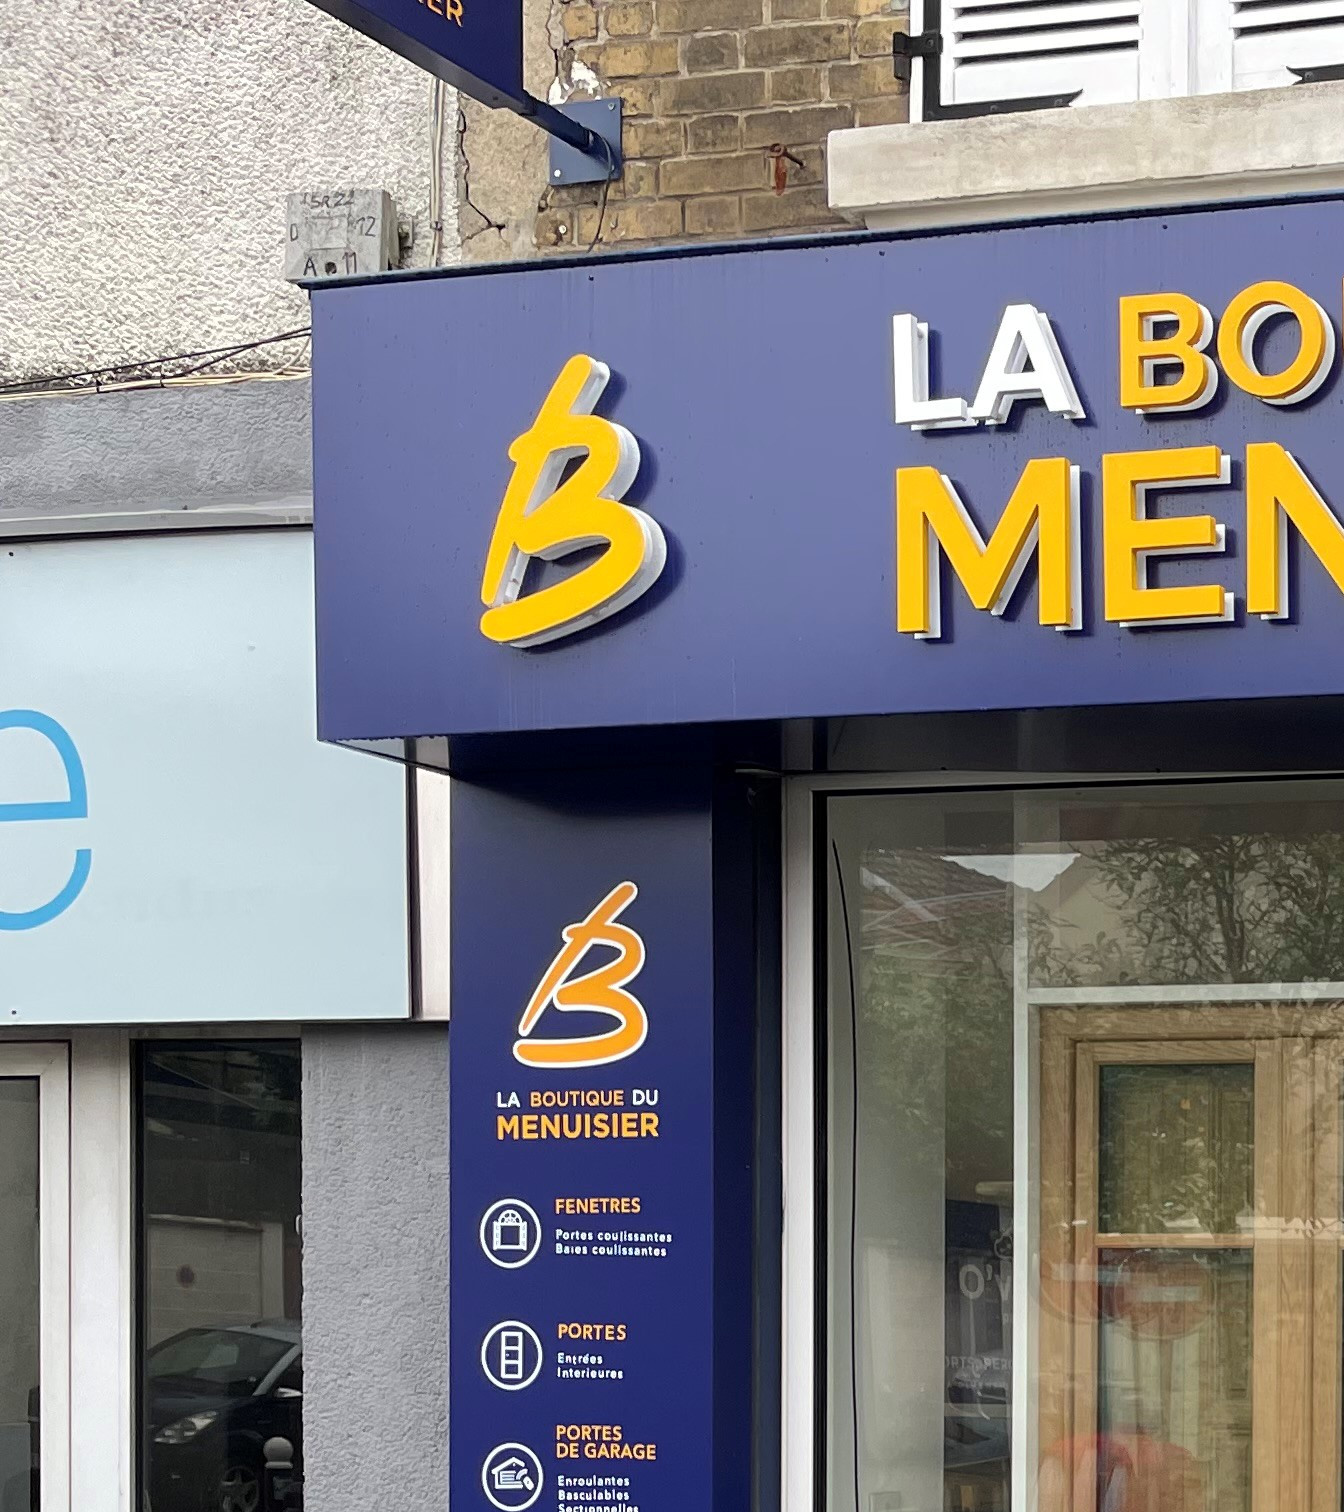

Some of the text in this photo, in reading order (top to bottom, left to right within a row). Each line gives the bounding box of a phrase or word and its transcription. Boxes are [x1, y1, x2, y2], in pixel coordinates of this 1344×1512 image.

[303, 256, 317, 276] A
[893, 304, 1086, 431] LA
[496, 1088, 659, 1108] LA BOUTIQUE DU
[496, 1112, 660, 1140] MENUISIER
[555, 1196, 641, 1215] FENETRES
[555, 1228, 673, 1243] Portes coulissantes
[555, 1242, 667, 1257] Baies coulissantes
[557, 1322, 627, 1341] PORTES
[557, 1351, 603, 1365] Entrées
[557, 1366, 624, 1379] Interieures
[556, 1424, 623, 1441] PORTES
[556, 1442, 657, 1461] DE GARAGE
[557, 1474, 630, 1487] Enroulantes
[558, 1488, 630, 1501] Basculables
